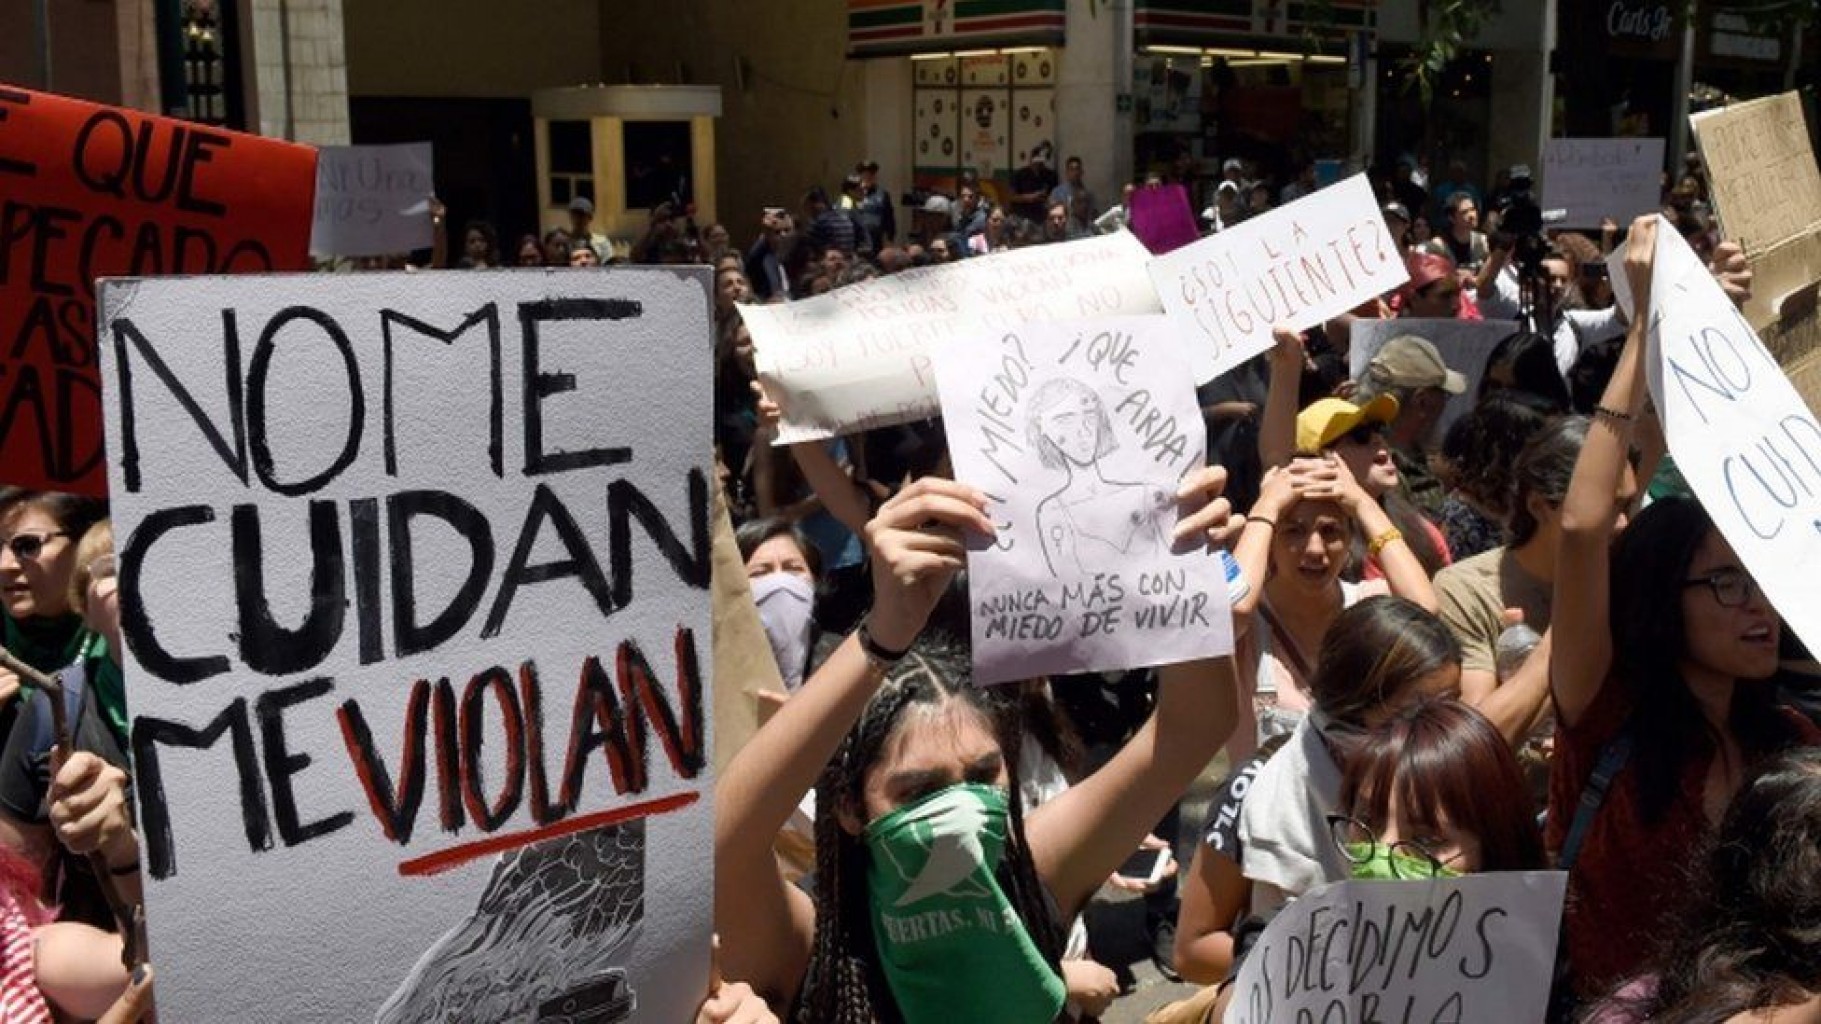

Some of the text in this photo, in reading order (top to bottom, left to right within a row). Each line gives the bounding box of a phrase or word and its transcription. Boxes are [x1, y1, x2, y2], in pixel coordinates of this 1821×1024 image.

[73, 110, 232, 217] QUE
[1193, 219, 1387, 361] SIGUIENTE?
[112, 297, 643, 496] NO ME
[1668, 326, 1752, 424] NO
[117, 467, 711, 684] CUIDAN
[979, 568, 1186, 618] NUNCA MÁS CON
[985, 591, 1210, 640] MIEDO DE VIVIR
[131, 623, 706, 881] ME VIOLAN
[1285, 889, 1508, 1000] DECIDIMOS
